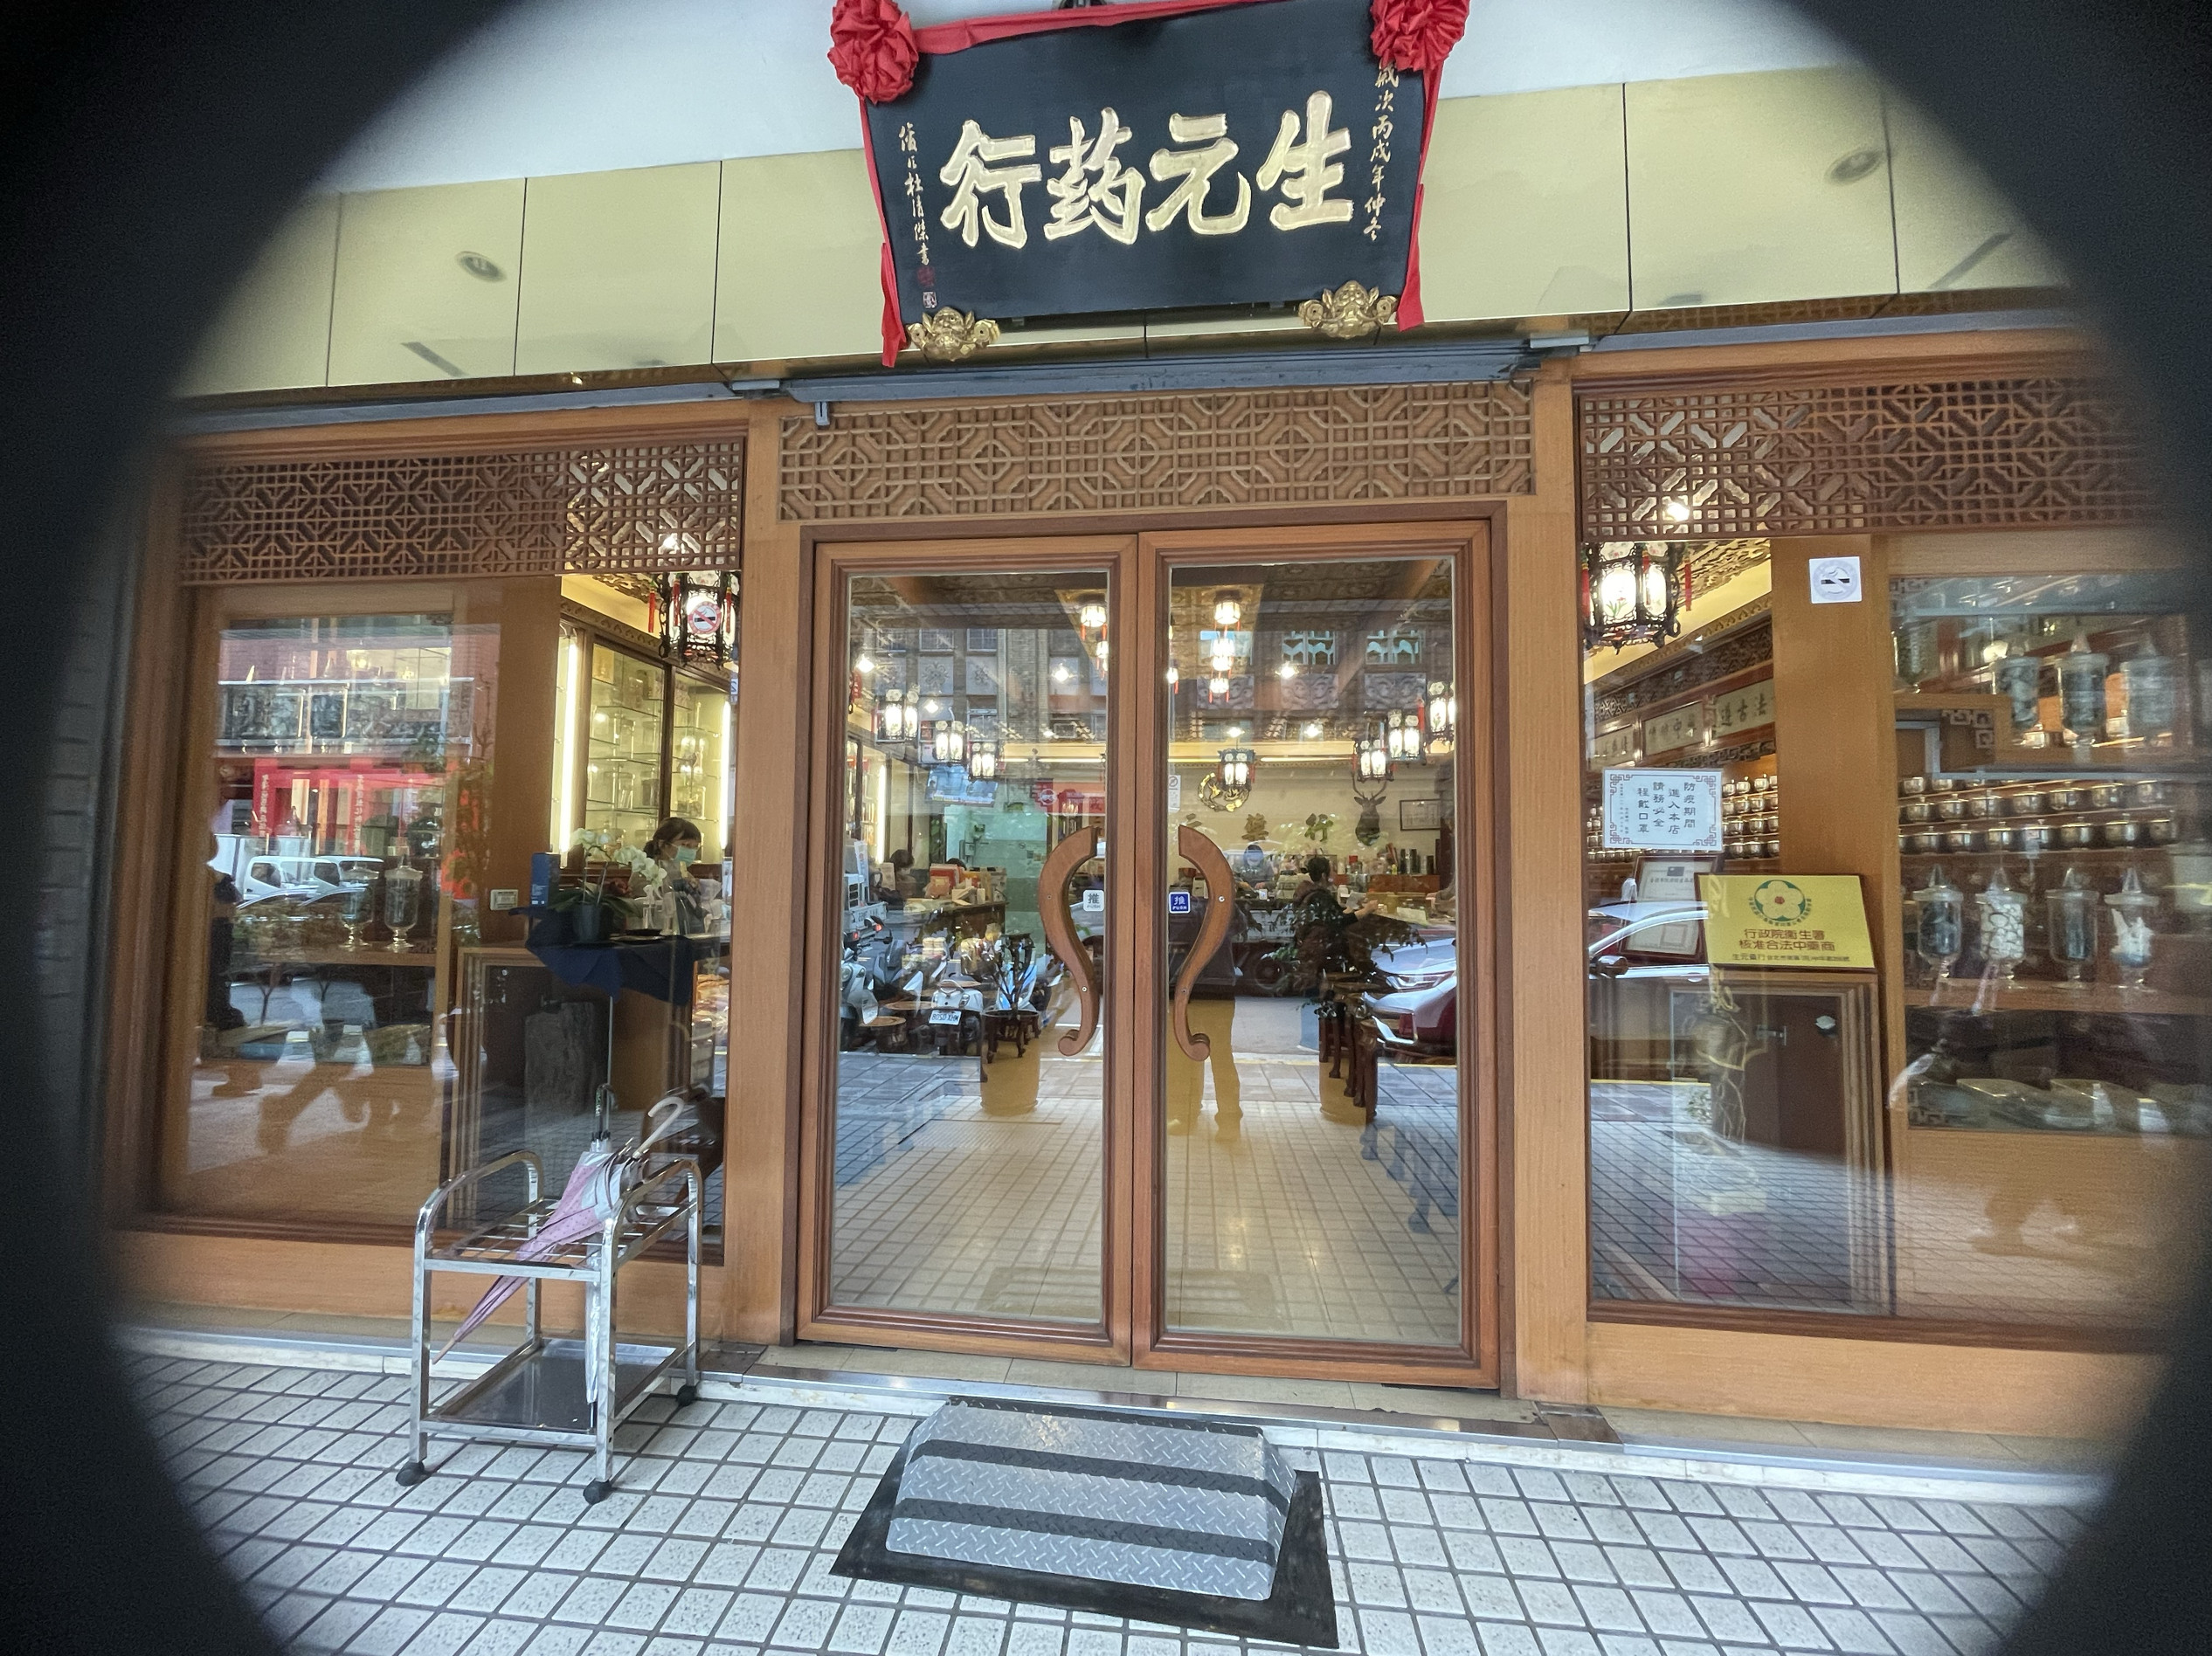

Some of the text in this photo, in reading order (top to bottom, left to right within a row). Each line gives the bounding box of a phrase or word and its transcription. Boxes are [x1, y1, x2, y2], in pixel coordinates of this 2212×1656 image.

[1636, 788, 1650, 833] 程戴口罩
[1668, 788, 1681, 834] 進入本店
[1683, 782, 1696, 828] 防疫期間
[1088, 893, 1100, 904] 推
[1174, 895, 1185, 905] 推
[1744, 928, 1825, 941] 行政院衛生署
[1739, 940, 1835, 952] 核准合法中藥商
